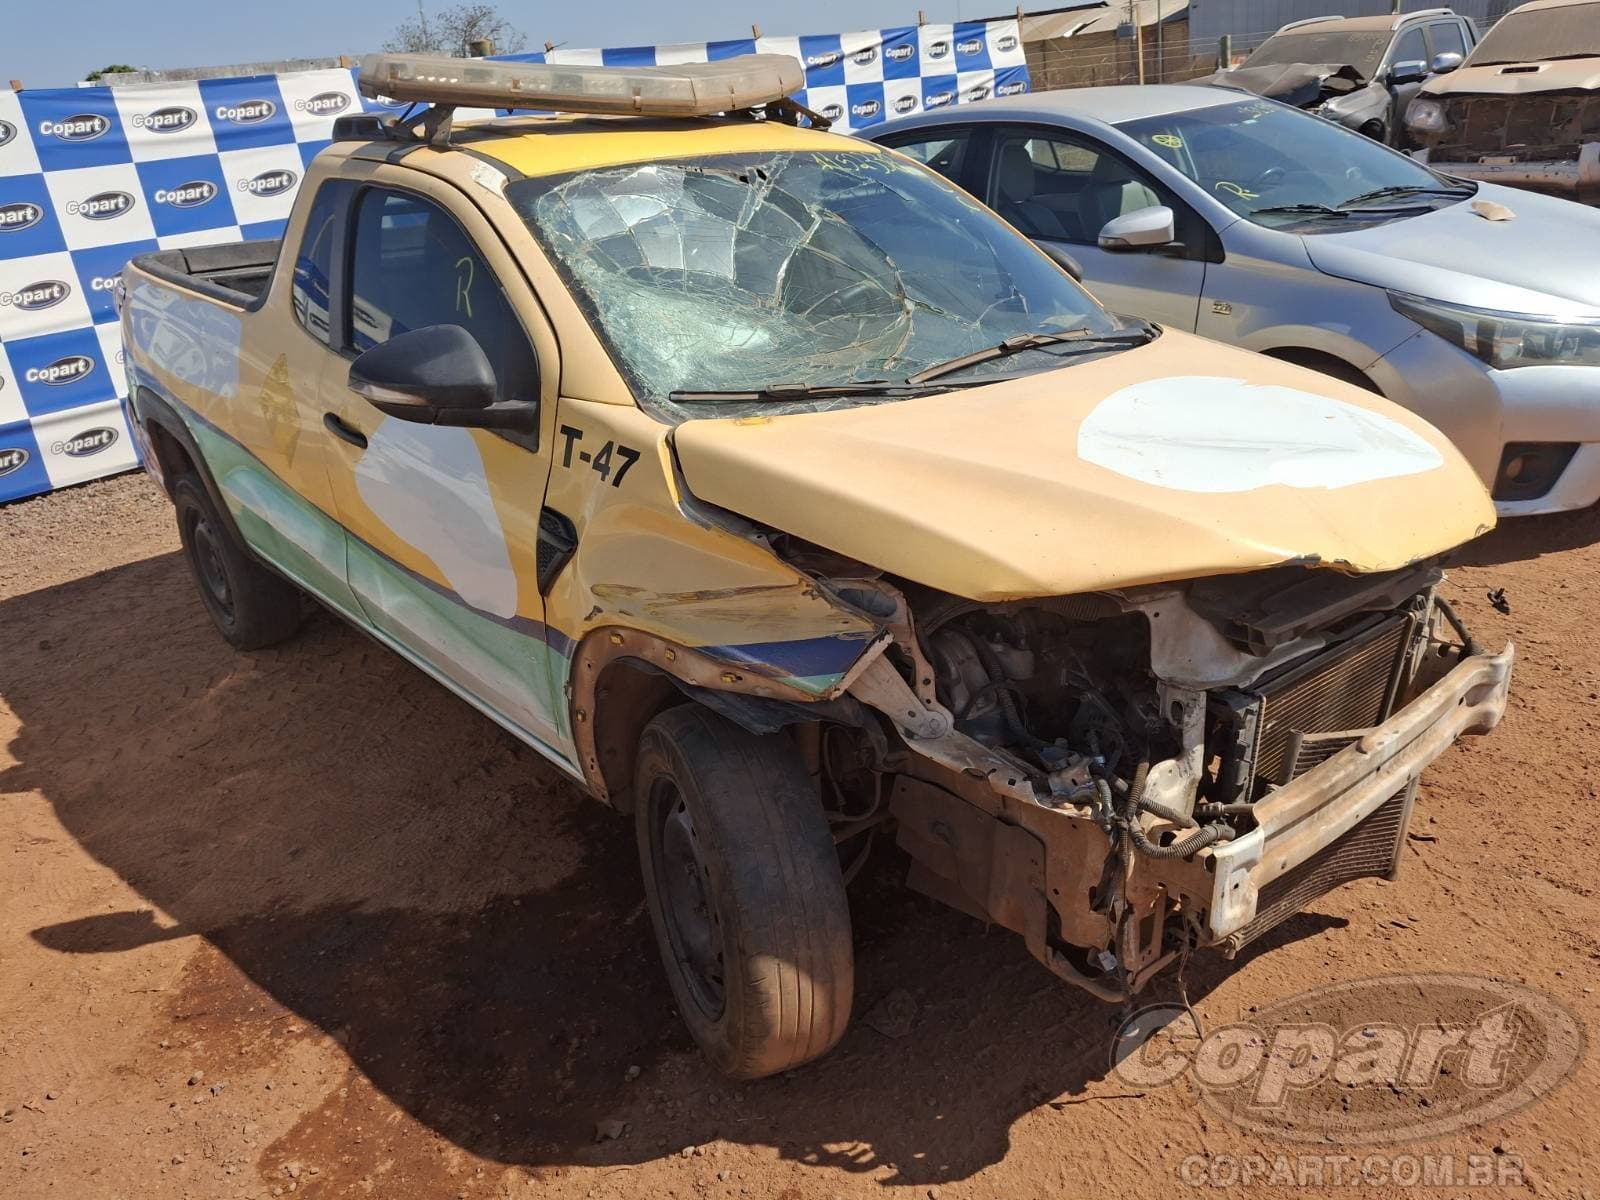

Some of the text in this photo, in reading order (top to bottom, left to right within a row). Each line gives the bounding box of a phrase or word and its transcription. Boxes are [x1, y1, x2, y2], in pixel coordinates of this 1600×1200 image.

[885, 46, 912, 59] Copart
[957, 42, 980, 54] Copart
[216, 103, 270, 120] Copart
[295, 95, 345, 111] Copart
[852, 102, 877, 115] Copart
[40, 117, 102, 139] Copart
[132, 110, 189, 131] Copart
[155, 183, 210, 203] Copart
[237, 173, 290, 193] Copart
[66, 195, 126, 218] Copart
[0, 284, 61, 306] Copart
[455, 256, 473, 318] R
[25, 358, 87, 382] Copart
[51, 431, 109, 455] Copart
[560, 424, 641, 488] T-47
